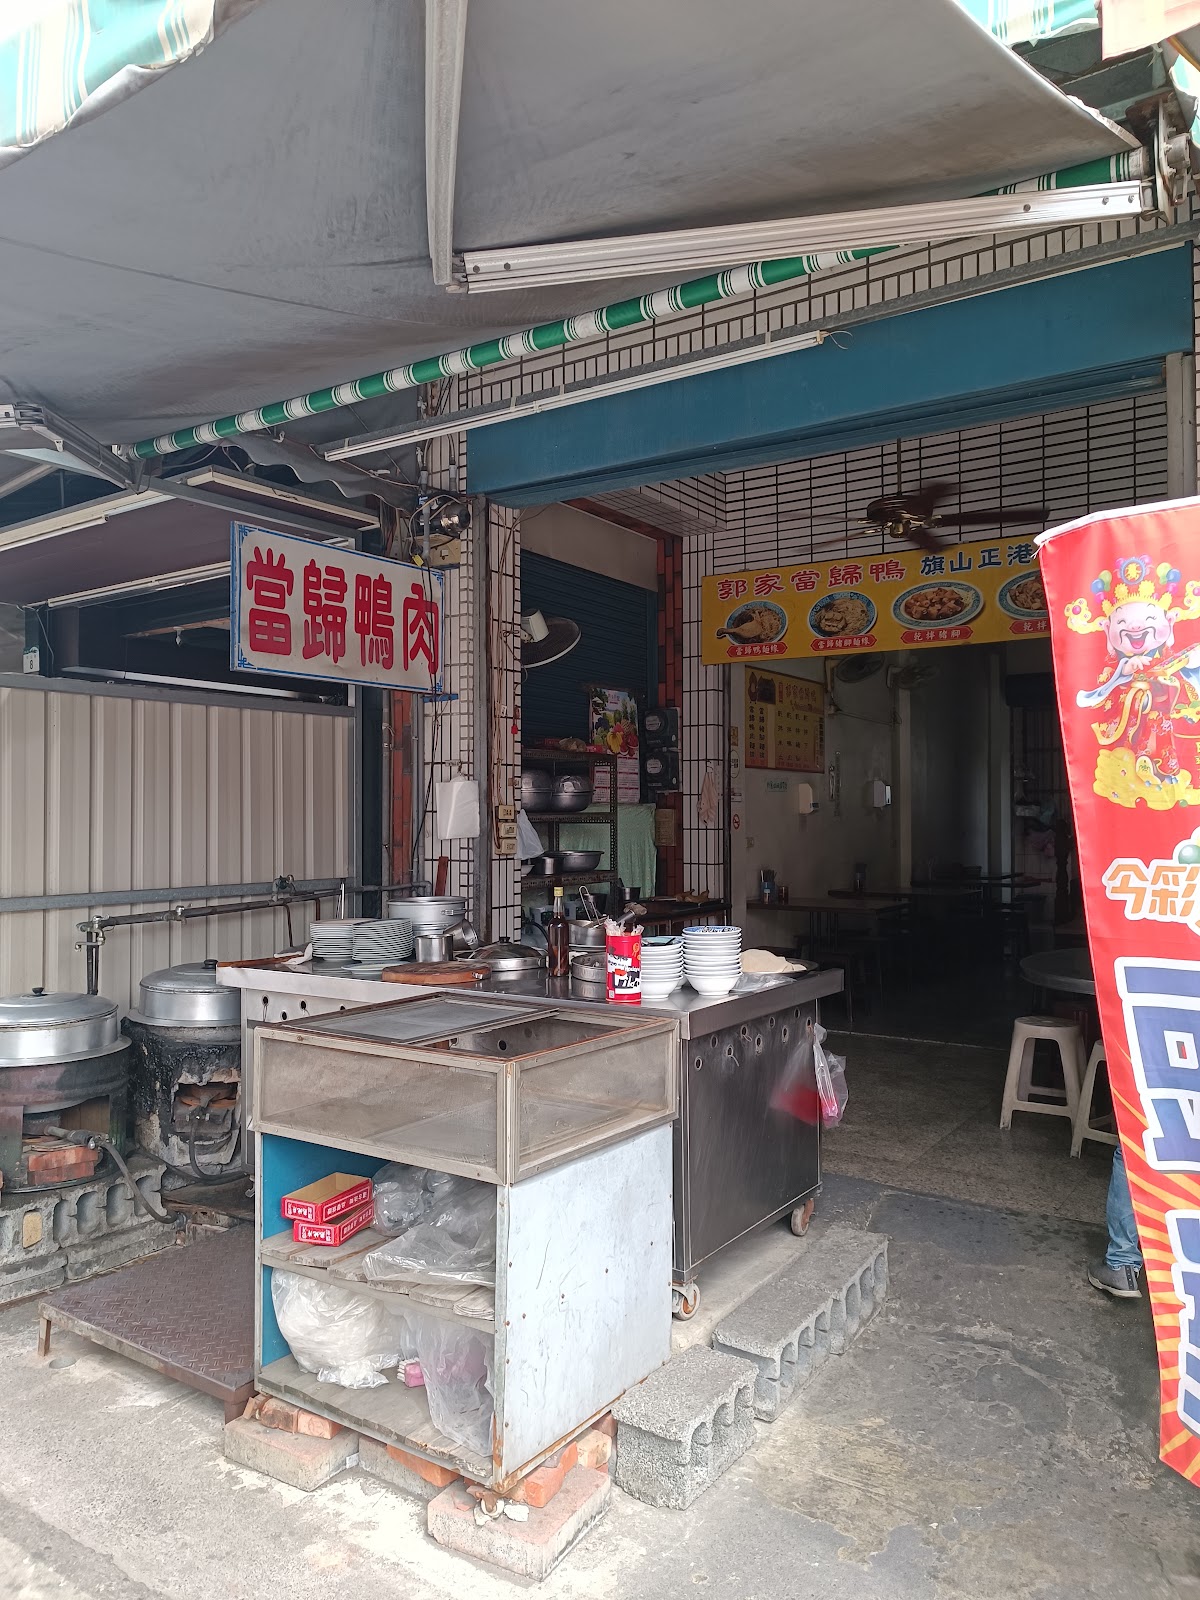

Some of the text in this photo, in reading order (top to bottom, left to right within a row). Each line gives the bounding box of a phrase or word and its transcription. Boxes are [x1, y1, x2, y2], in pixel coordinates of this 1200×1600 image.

[246, 545, 440, 676] 當歸鴨肉
[716, 543, 1034, 601] 郭家當歸鴨 旗山正港
